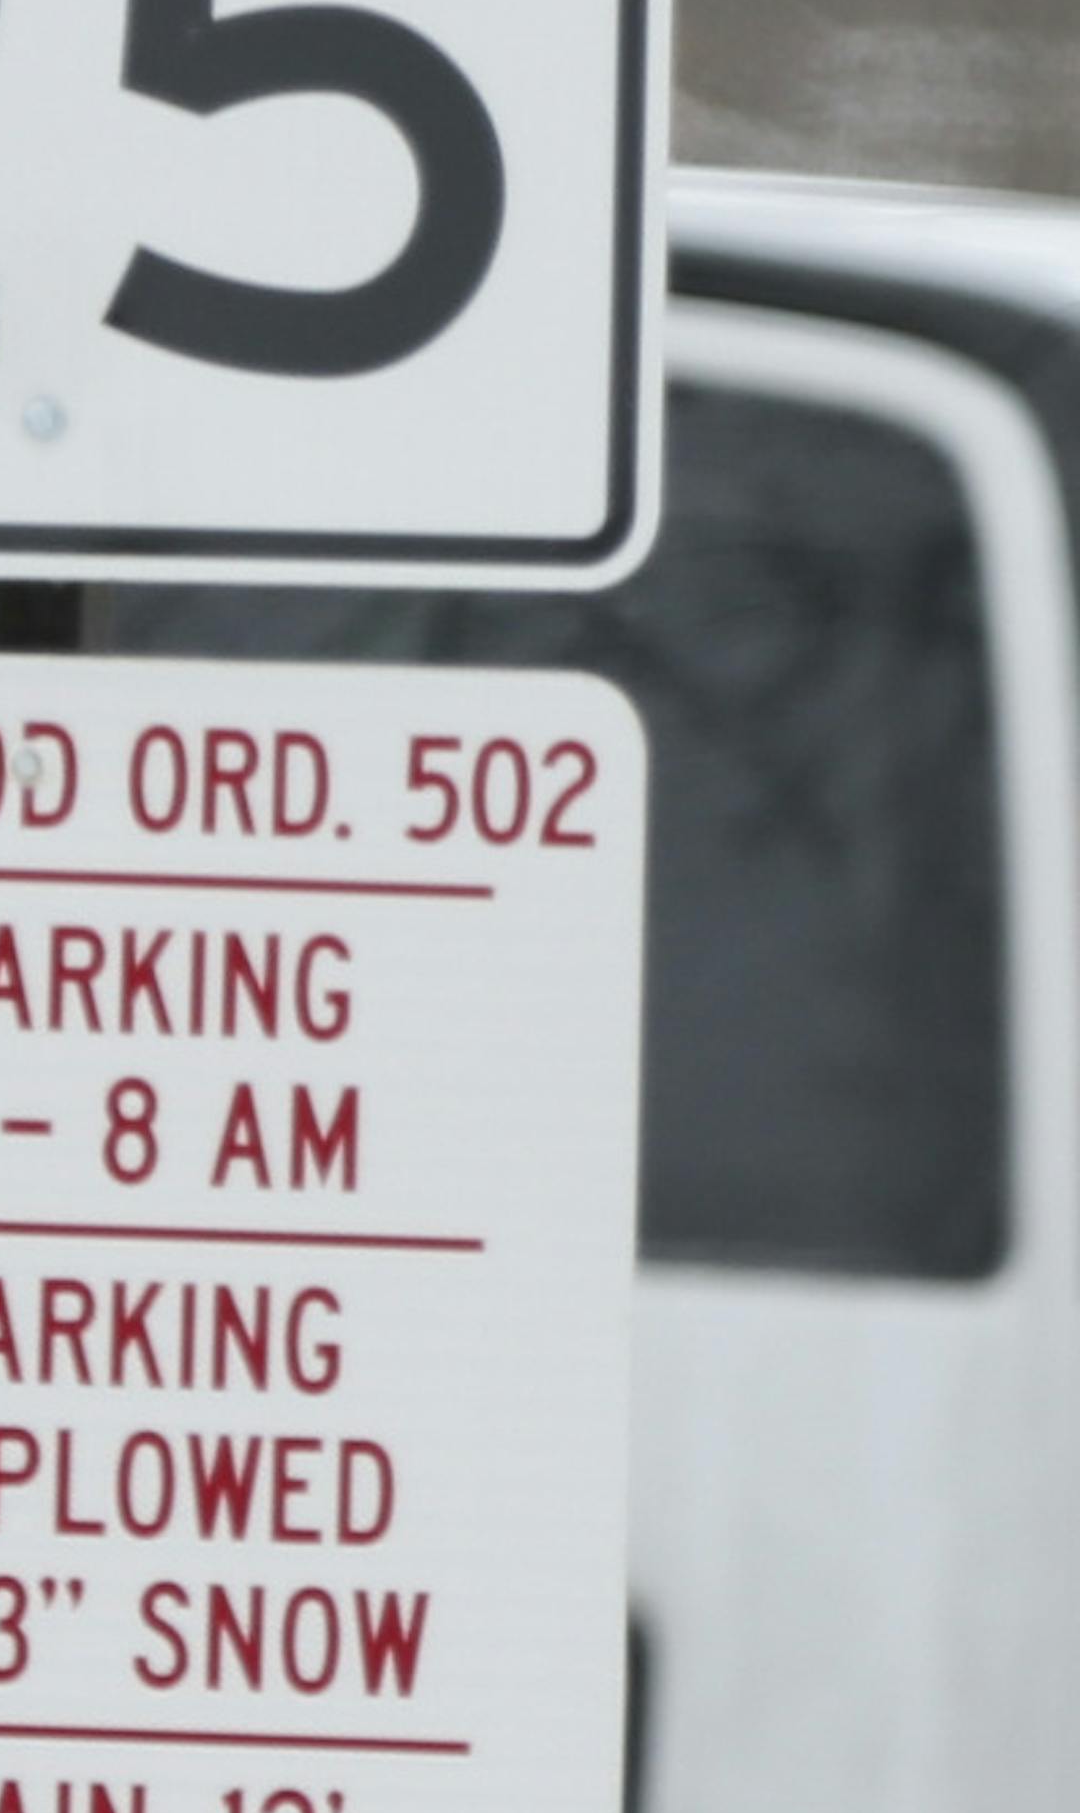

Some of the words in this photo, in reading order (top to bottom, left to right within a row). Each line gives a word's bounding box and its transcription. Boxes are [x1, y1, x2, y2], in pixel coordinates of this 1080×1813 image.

[128, 725, 352, 842] ORD.
[406, 735, 599, 848] 502
[102, 1076, 160, 1185] 8
[212, 1084, 362, 1192] AM
[133, 1581, 430, 1697] SNOW
